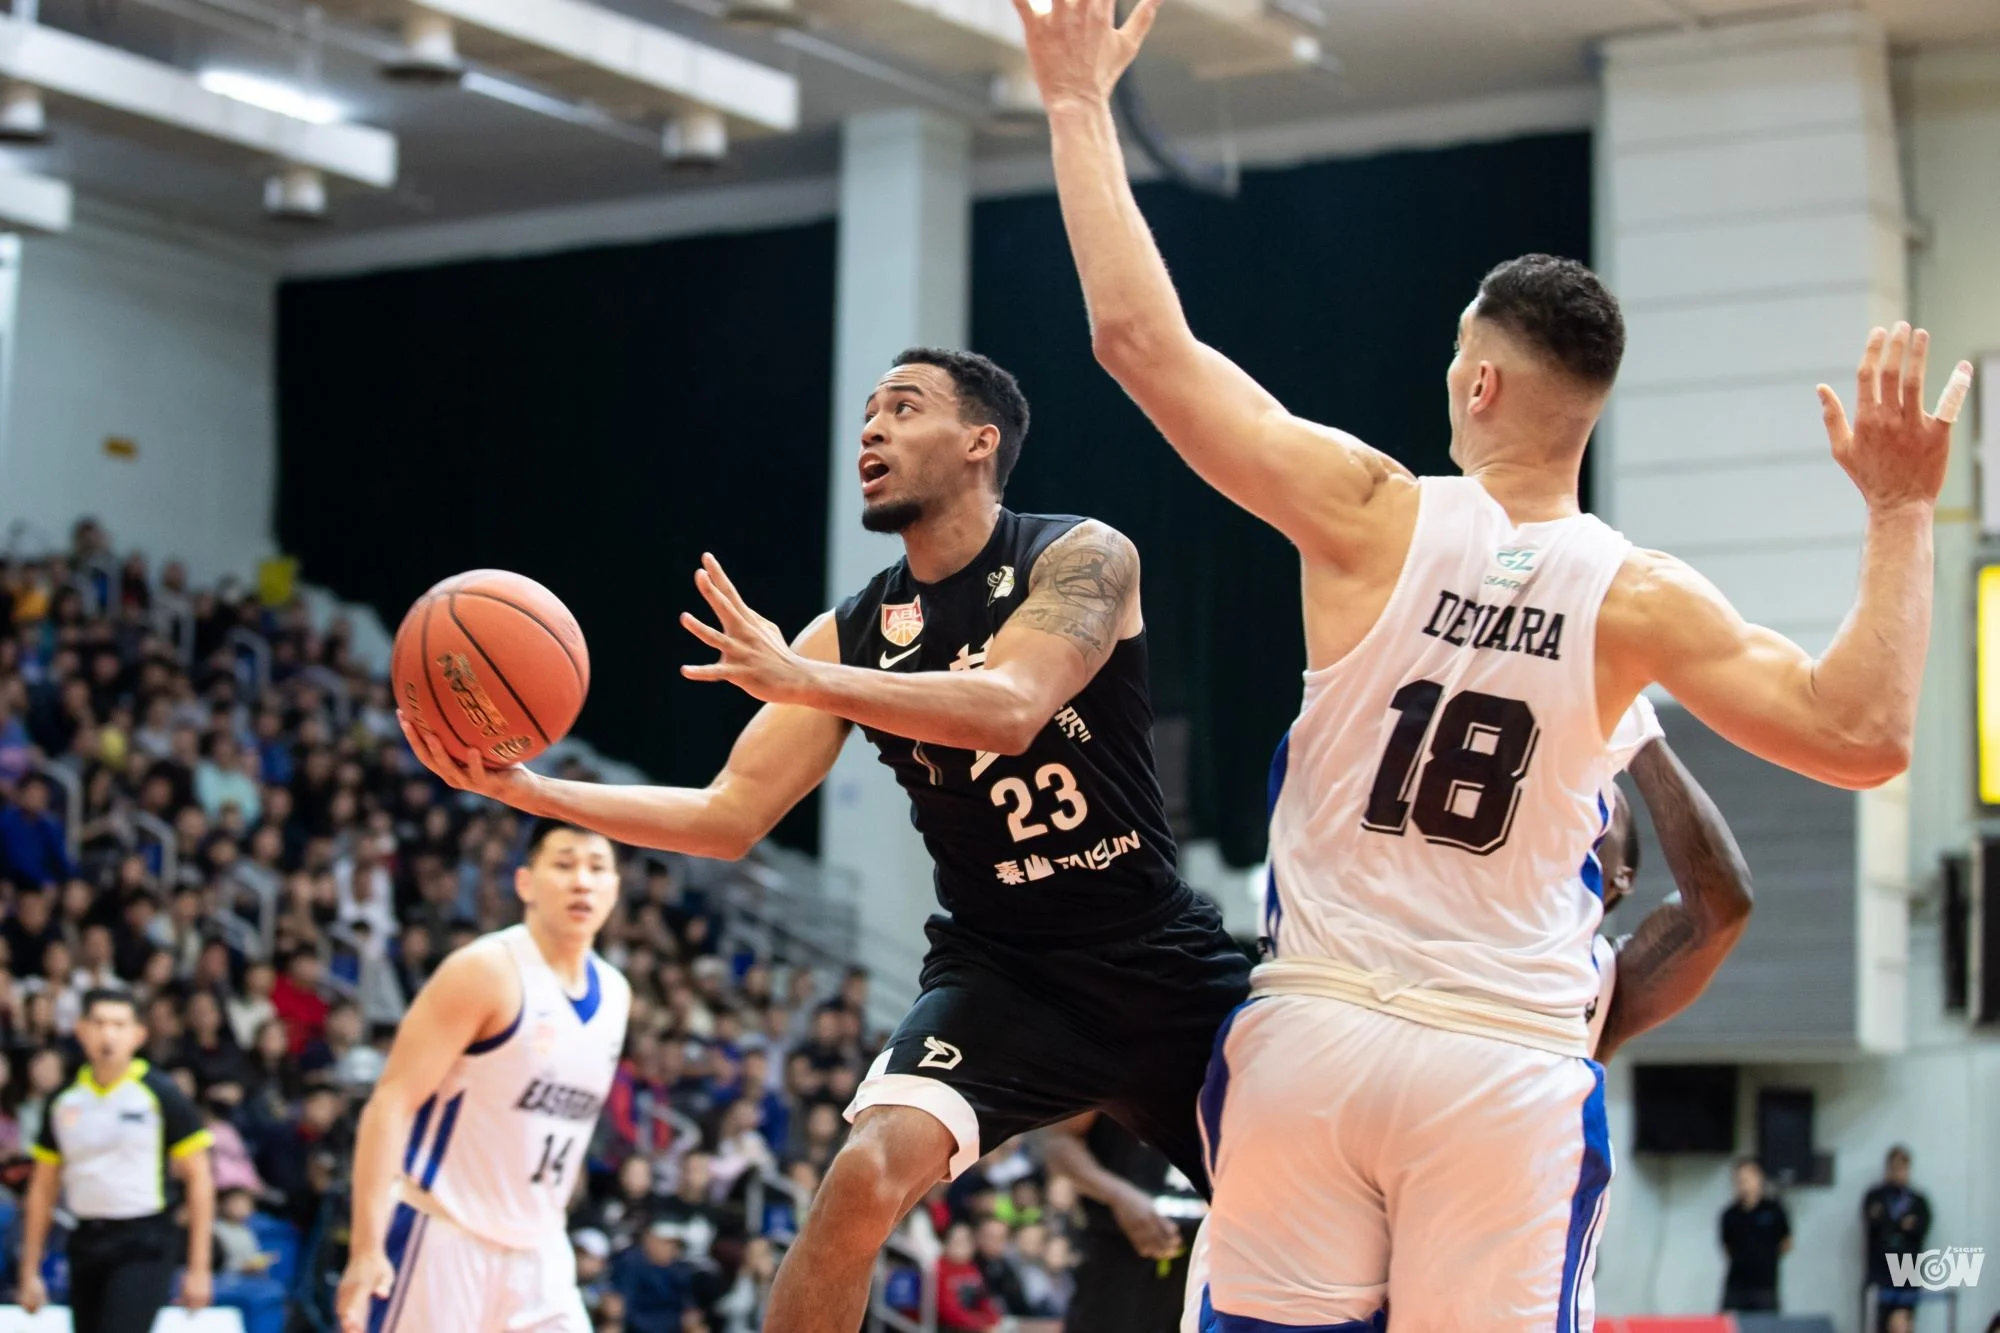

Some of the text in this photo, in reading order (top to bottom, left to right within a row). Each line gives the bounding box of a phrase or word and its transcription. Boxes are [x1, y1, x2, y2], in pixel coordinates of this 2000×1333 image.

[886, 607, 922, 626] ABL
[1360, 679, 1541, 857] 18
[989, 763, 1089, 843] 23
[1052, 829, 1141, 870] TAISUN
